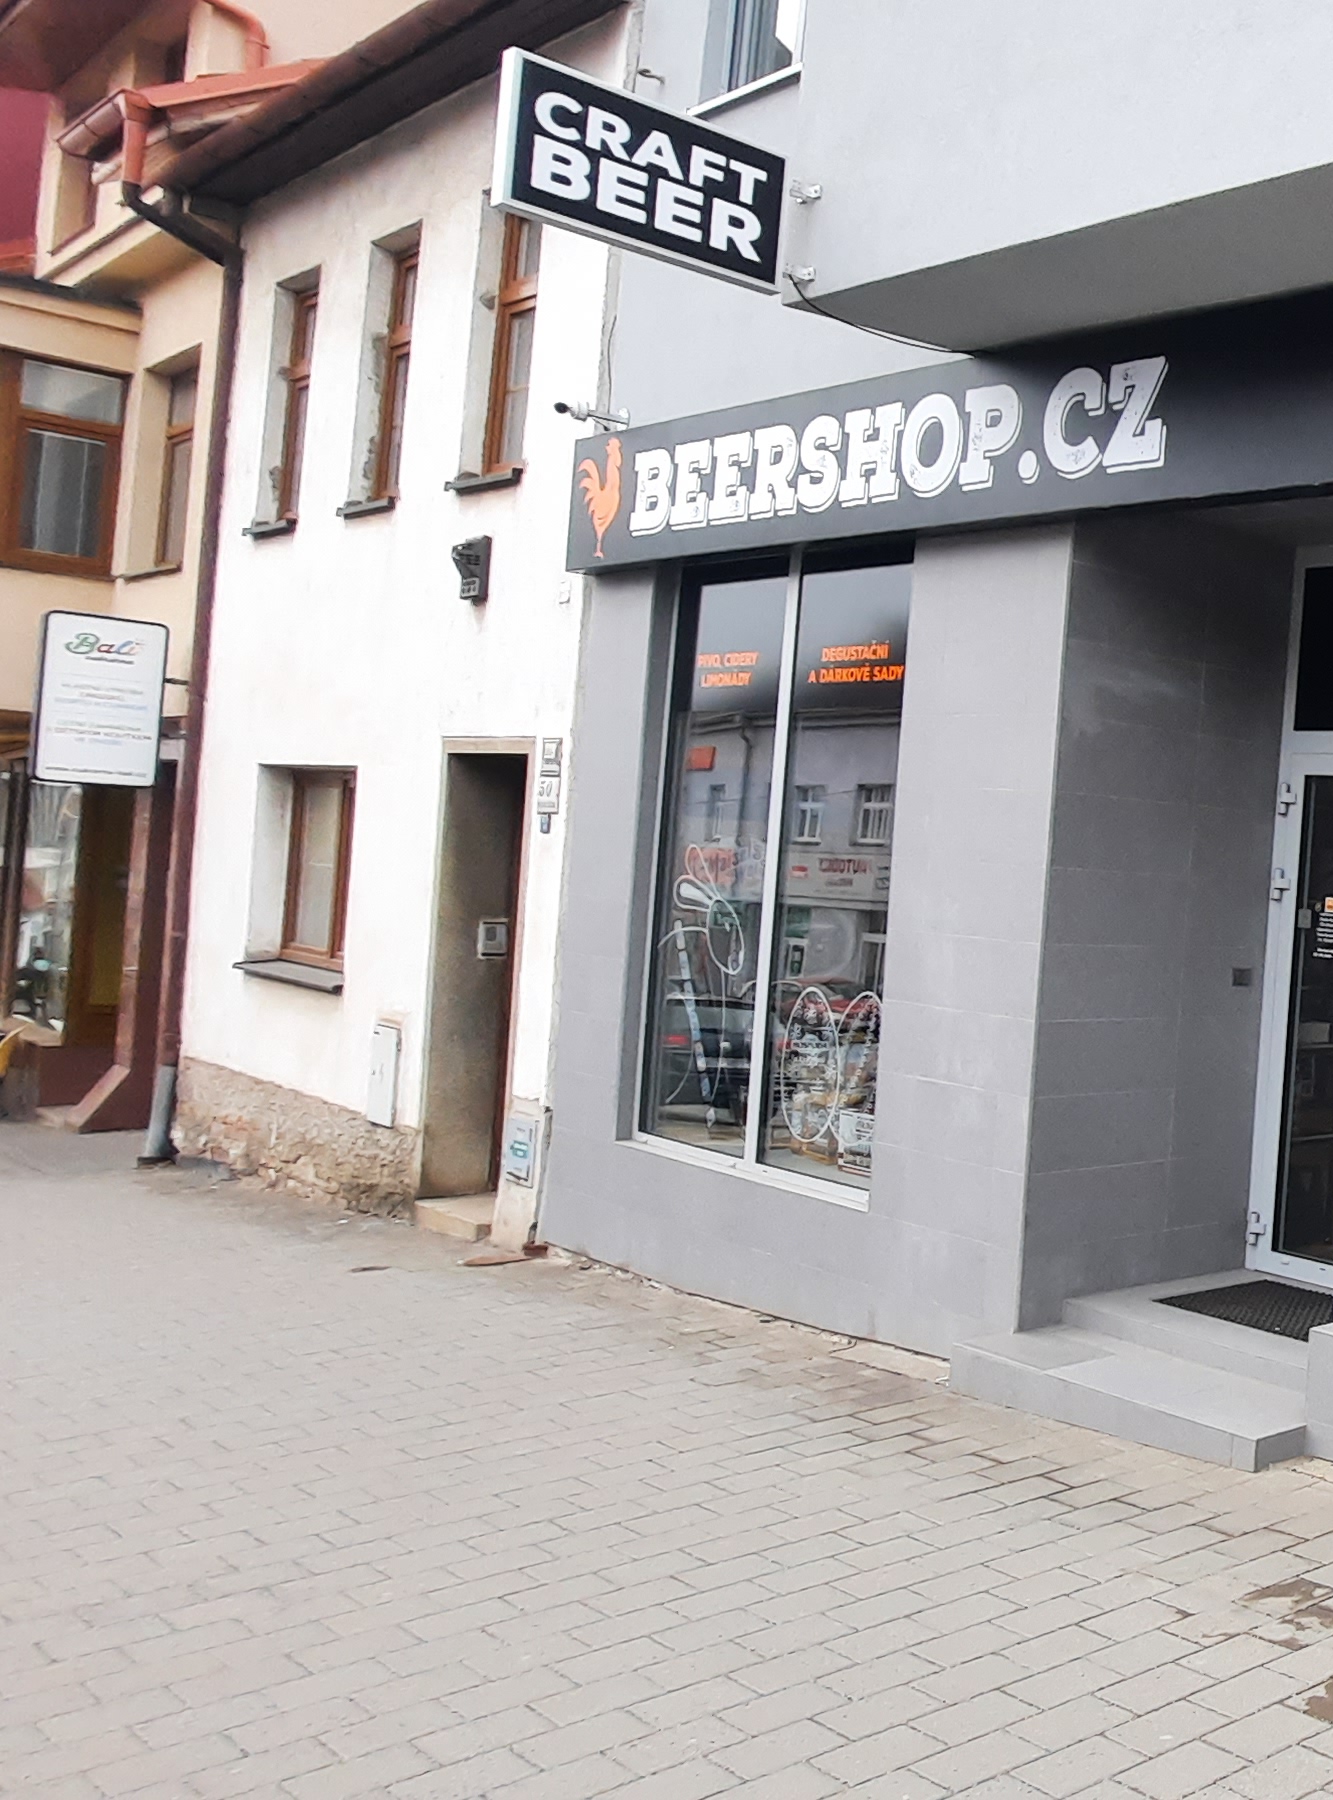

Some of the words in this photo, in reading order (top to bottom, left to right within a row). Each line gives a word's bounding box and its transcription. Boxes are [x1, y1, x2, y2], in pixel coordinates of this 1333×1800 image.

[534, 91, 768, 206] CRAFT
[530, 135, 762, 263] BEER
[629, 355, 1169, 537] BEERSHOP.CZ
[724, 651, 760, 667] CIDERY
[808, 671, 817, 683] A
[873, 664, 905, 682] SADY
[820, 639, 890, 662] DEGUSTAČNÍ
